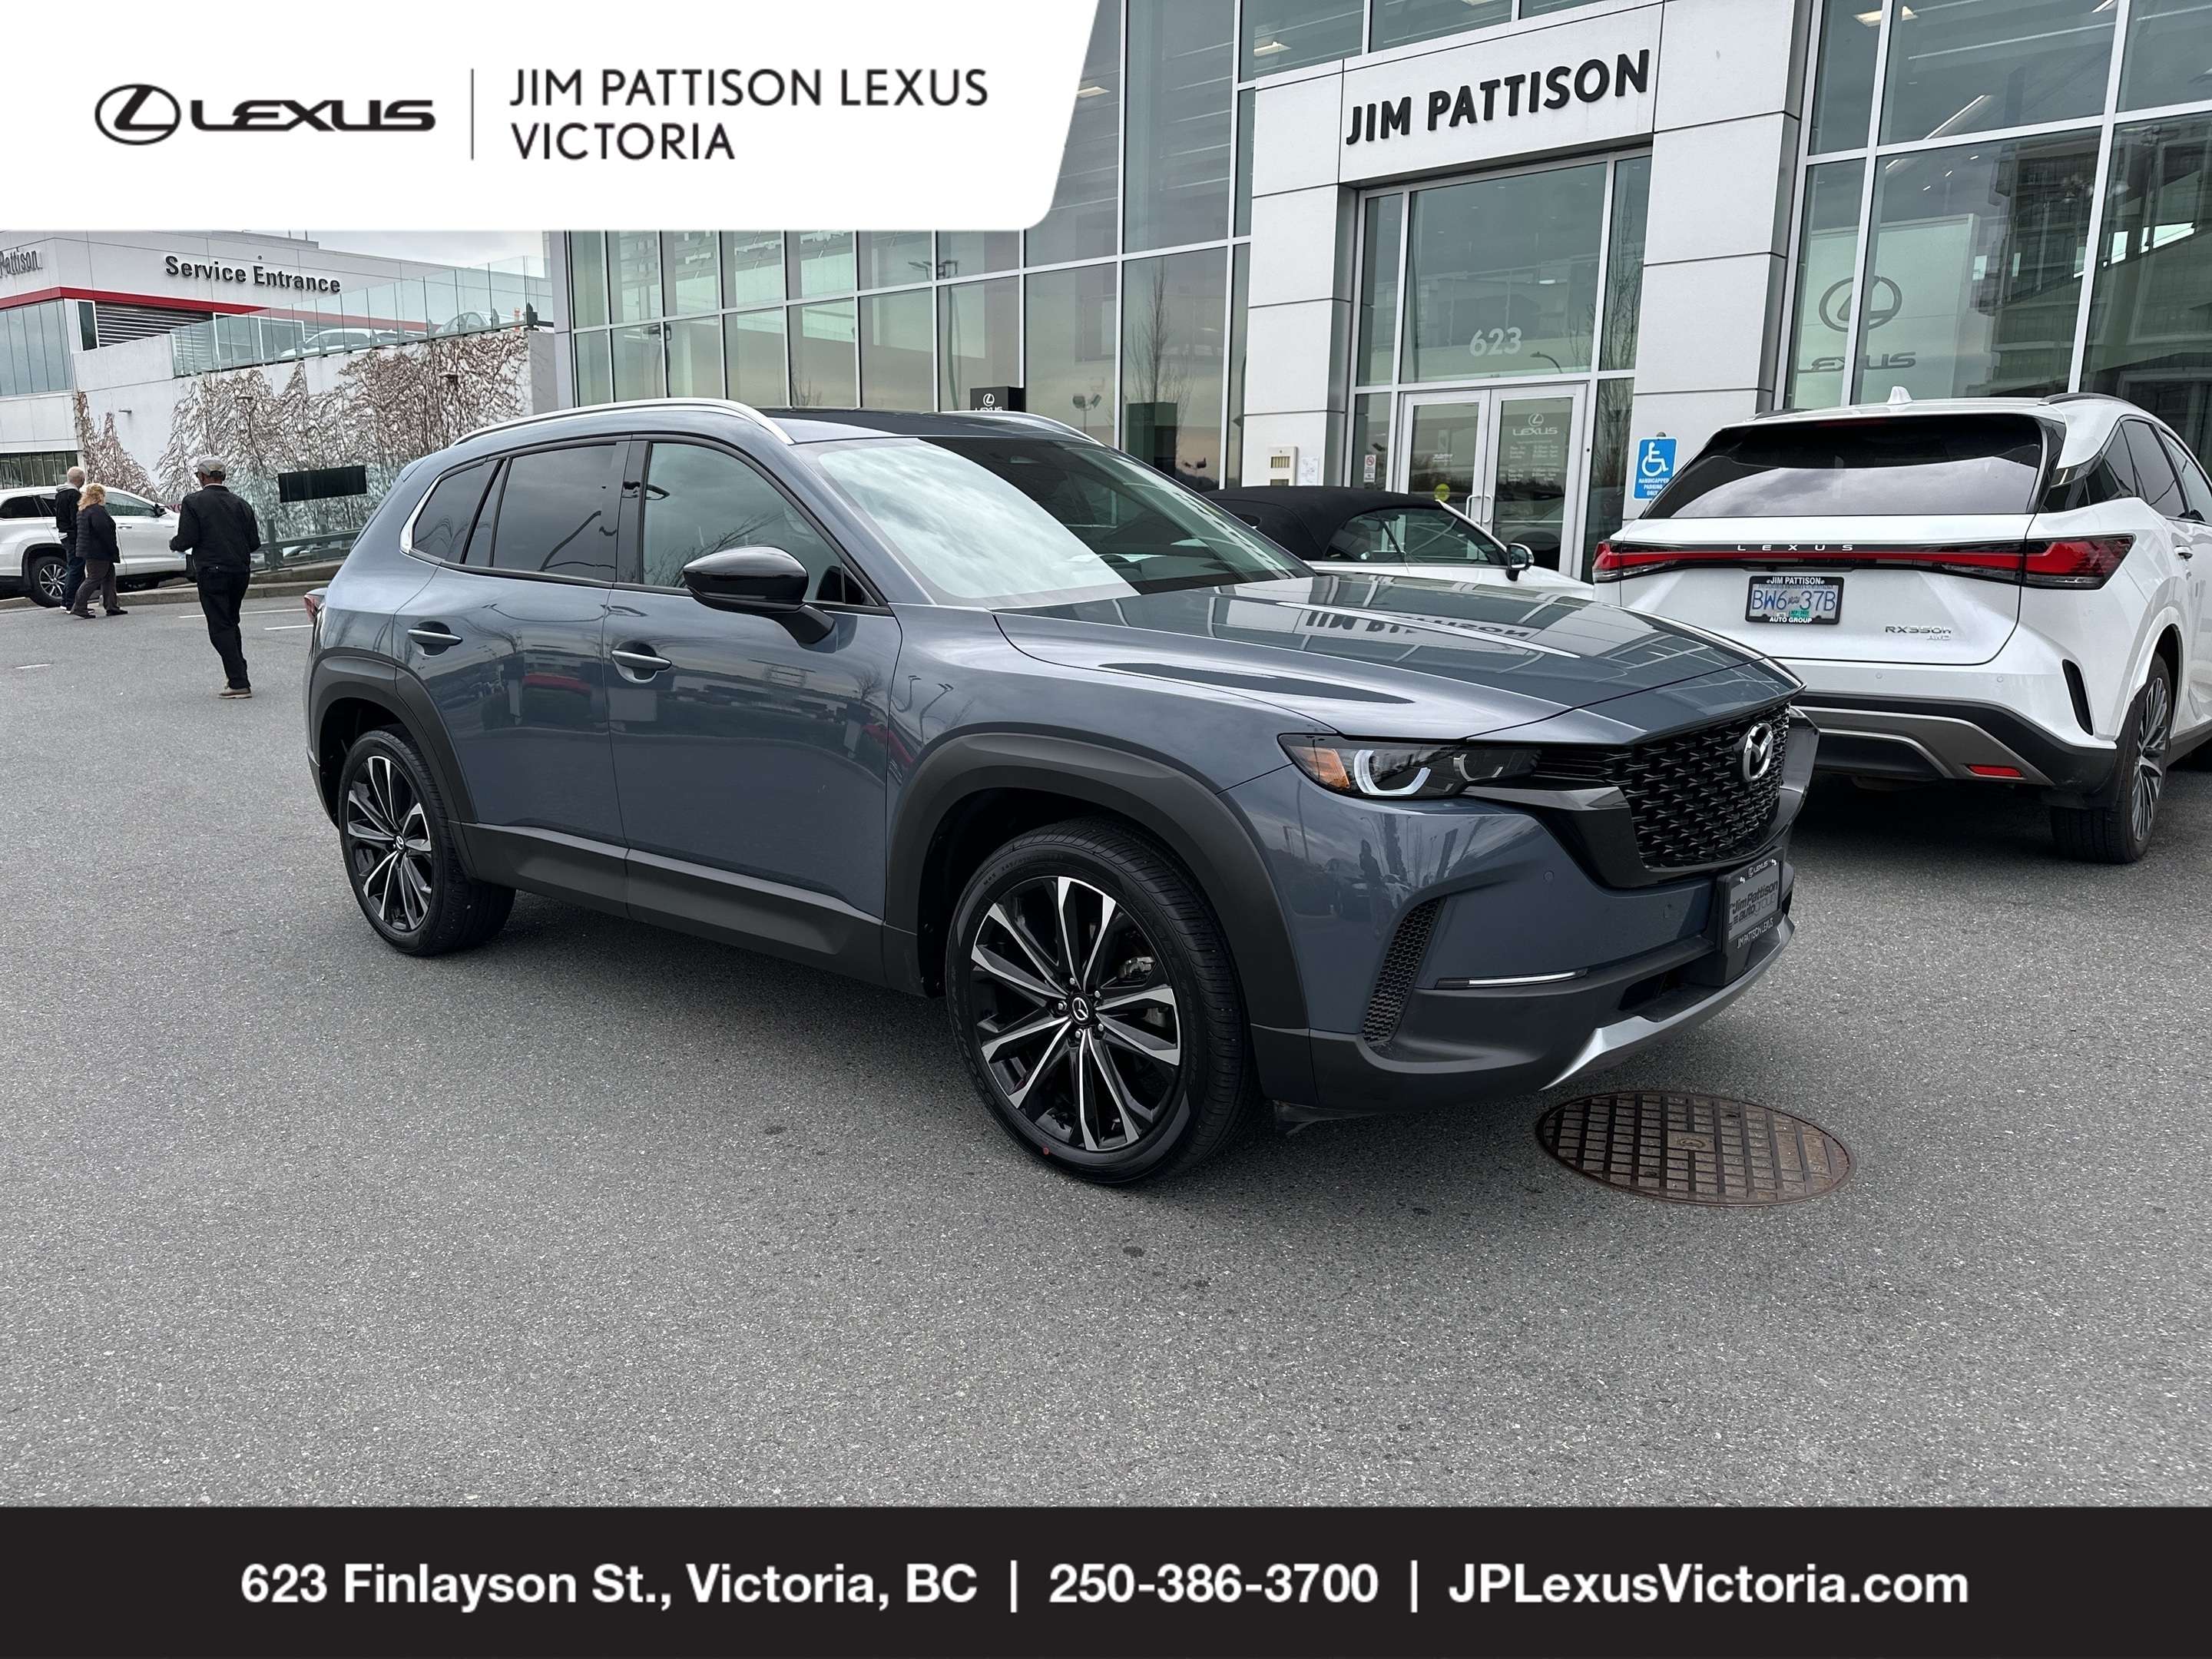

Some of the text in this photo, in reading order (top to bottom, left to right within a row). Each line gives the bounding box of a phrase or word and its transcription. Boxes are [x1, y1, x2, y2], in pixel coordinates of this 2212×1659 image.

[1346, 48, 1650, 145] JIM PATTISON
[165, 255, 341, 293] Service Entrance
[1469, 326, 1522, 357] 623
[1512, 426, 1558, 436] LEXUS
[1752, 590, 1836, 611] BW6 37B
[1885, 626, 1952, 634] RX350h
[1731, 881, 1778, 915] Jim Pattison
[1738, 892, 1777, 923] autogroup
